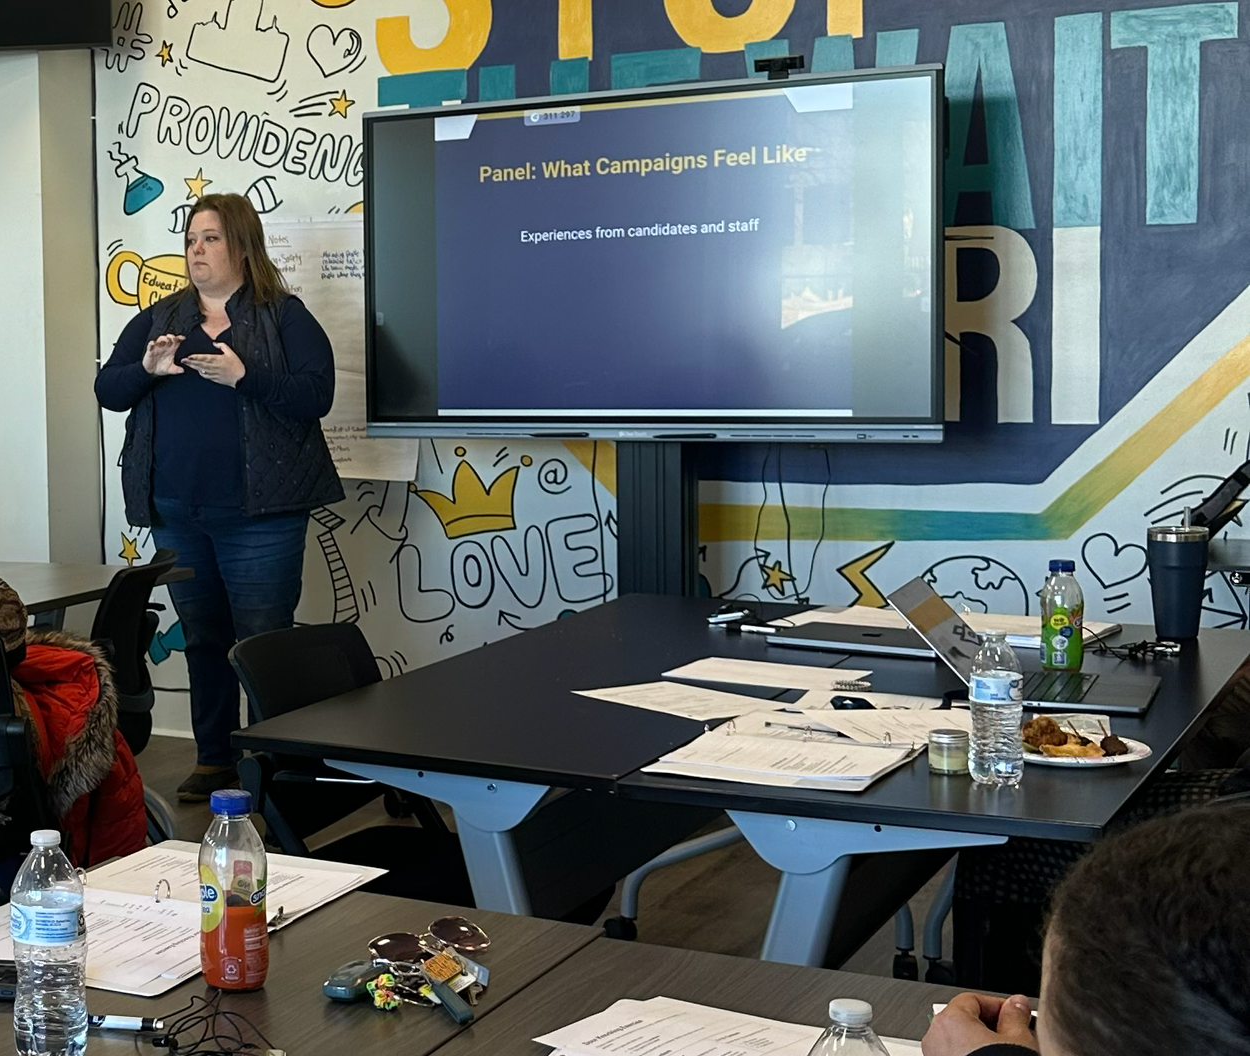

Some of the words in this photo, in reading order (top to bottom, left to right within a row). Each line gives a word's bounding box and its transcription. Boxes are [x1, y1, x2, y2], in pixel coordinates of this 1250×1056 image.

[744, 2, 1237, 230] AIT
[479, 162, 536, 183] Panel:
[543, 158, 590, 179] What
[596, 153, 708, 176] Campaigns
[714, 147, 756, 167] Feel
[763, 144, 807, 164] Like
[520, 229, 592, 244] Experiences
[595, 225, 625, 239] from
[627, 220, 697, 237] candidates
[700, 220, 725, 234] and
[728, 218, 759, 232] staff
[398, 514, 613, 623] LOVE
